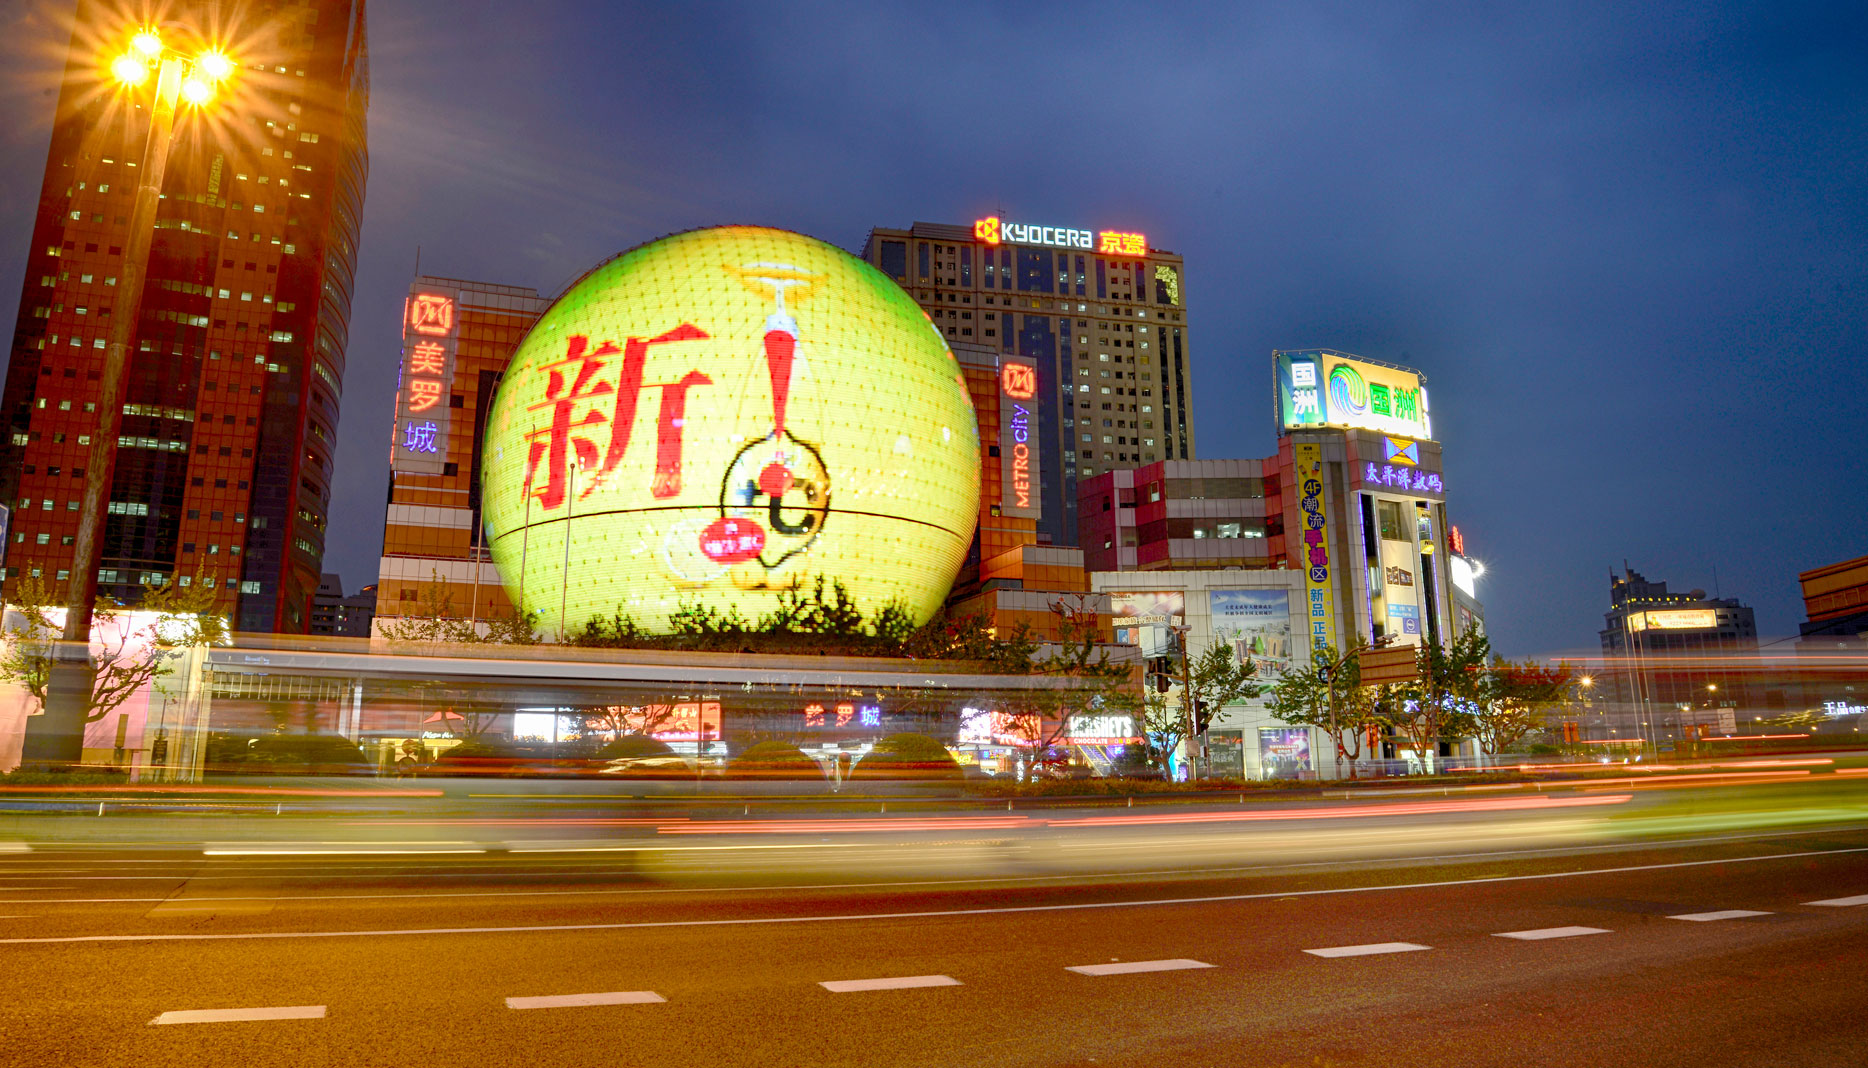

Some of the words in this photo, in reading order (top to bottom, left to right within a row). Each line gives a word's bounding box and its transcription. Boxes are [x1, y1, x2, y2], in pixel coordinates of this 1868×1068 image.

[1001, 222, 1093, 249] KYOCERA
[1099, 231, 1146, 256] 京瓷
[402, 340, 446, 453] 美罗城
[1291, 362, 1320, 415] 国洲
[1370, 384, 1417, 423] 国洲
[521, 321, 713, 511] 新
[1365, 462, 1444, 493] 太平洋数码
[1310, 587, 1325, 617] 新品
[804, 704, 881, 728] 美罗城
